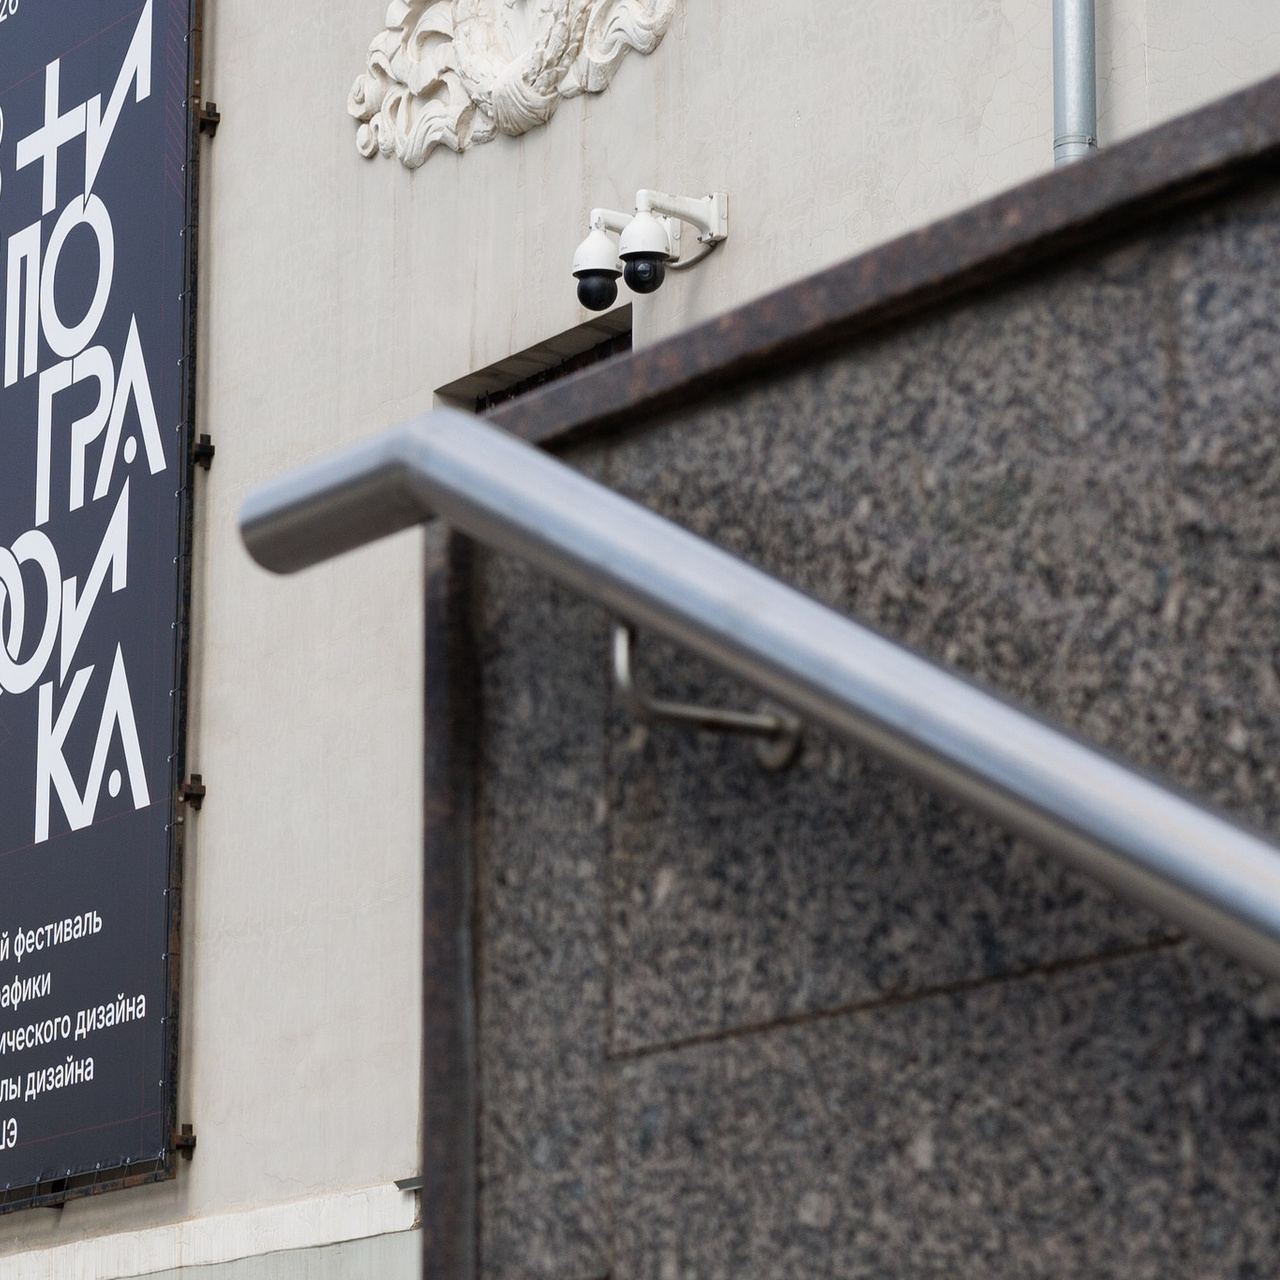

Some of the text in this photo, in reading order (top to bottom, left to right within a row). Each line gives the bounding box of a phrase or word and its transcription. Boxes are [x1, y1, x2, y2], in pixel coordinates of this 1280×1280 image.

[13, 910, 103, 963] фестиваль
[74, 992, 146, 1041] дизайна
[24, 1055, 94, 1102] дизайна
